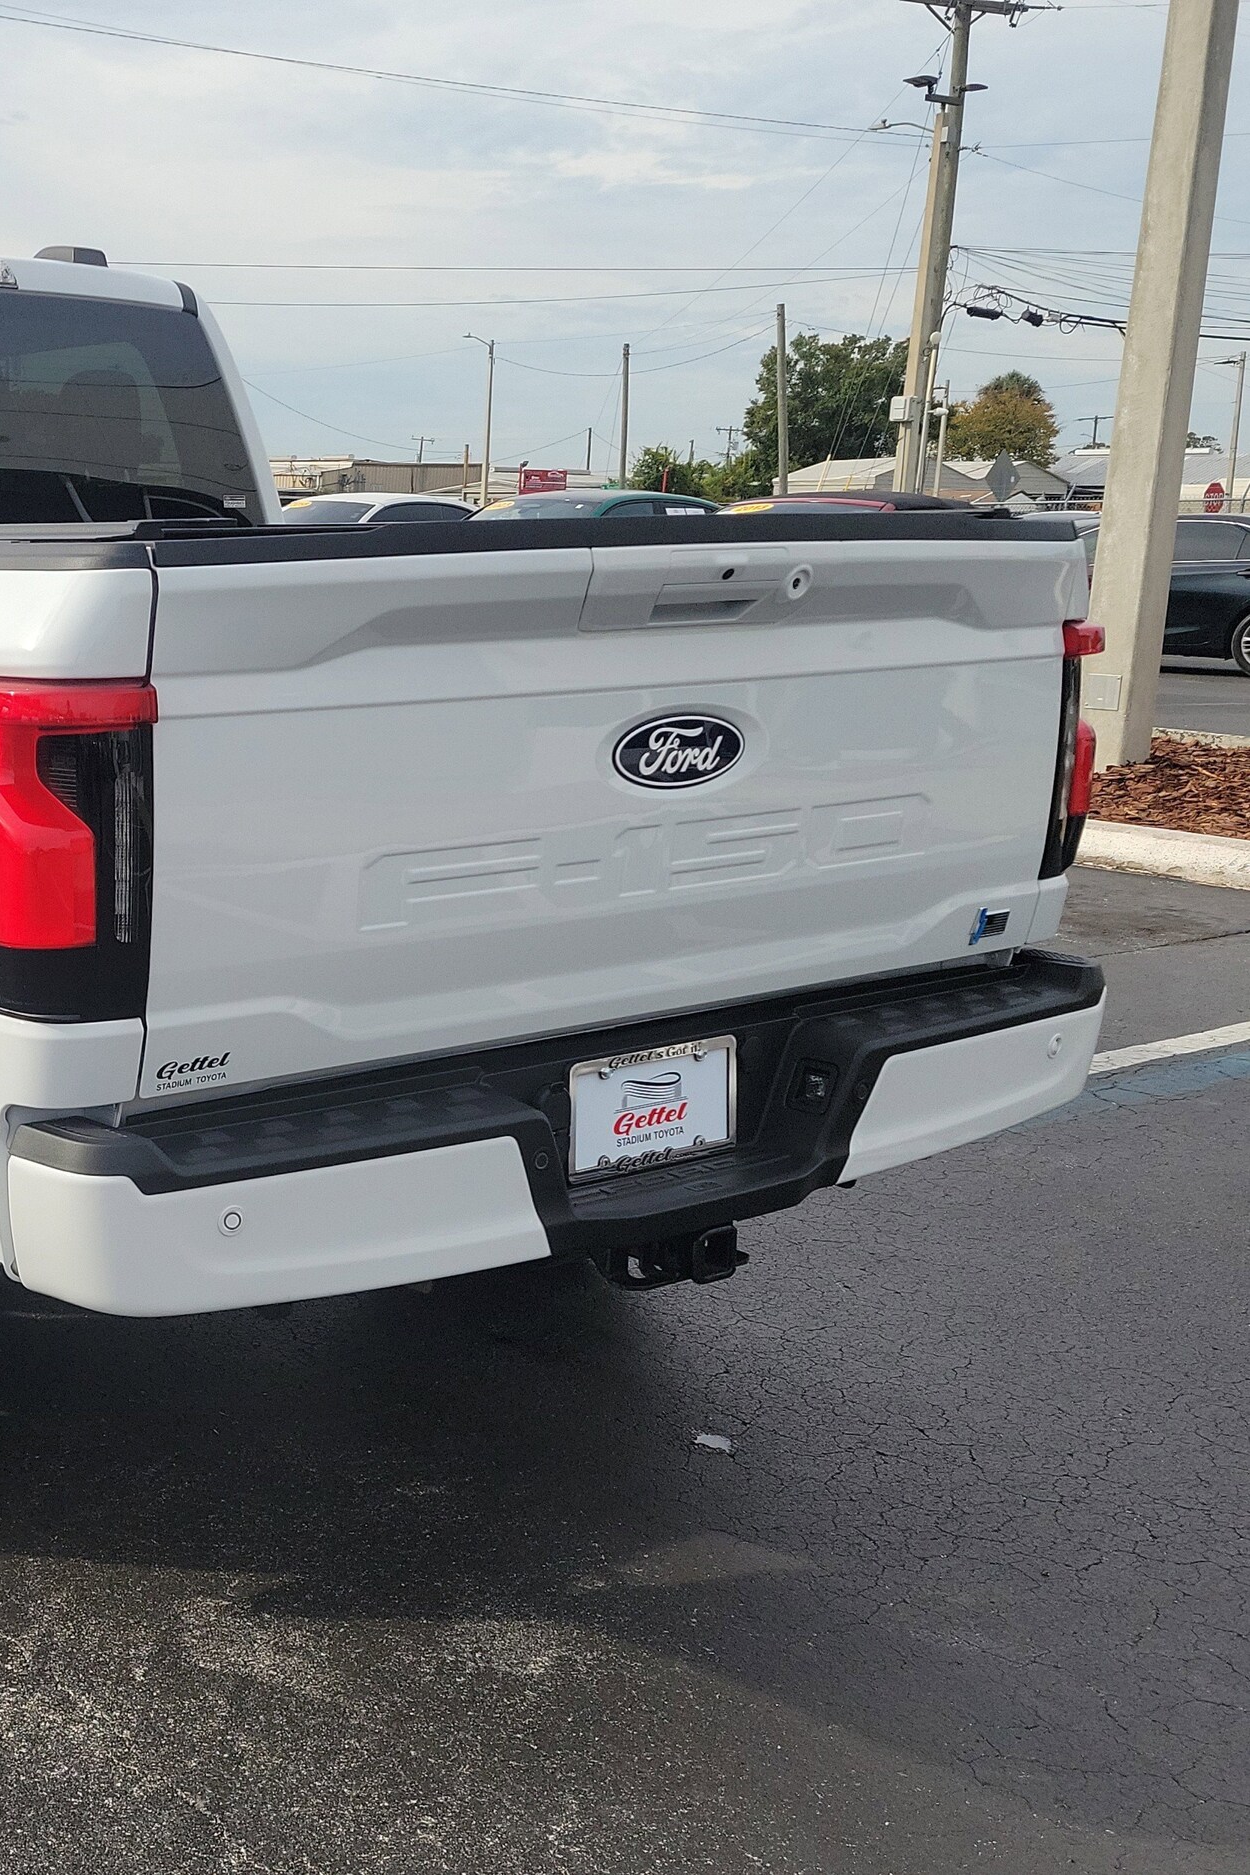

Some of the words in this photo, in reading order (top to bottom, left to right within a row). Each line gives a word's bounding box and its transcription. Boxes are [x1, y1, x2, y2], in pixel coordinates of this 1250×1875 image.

[1204, 492, 1224, 506] STOP
[638, 726, 724, 776] Ford
[359, 793, 931, 932] F-150
[156, 1051, 231, 1080] Gettel
[609, 1050, 664, 1069] Gettel's
[666, 1046, 686, 1057] Got
[156, 1078, 192, 1091] STADIUM
[196, 1072, 227, 1084] TOYOTA
[613, 1101, 688, 1136] Gettel
[616, 1132, 652, 1147] STADIUM
[654, 1126, 685, 1140] TOYOTA
